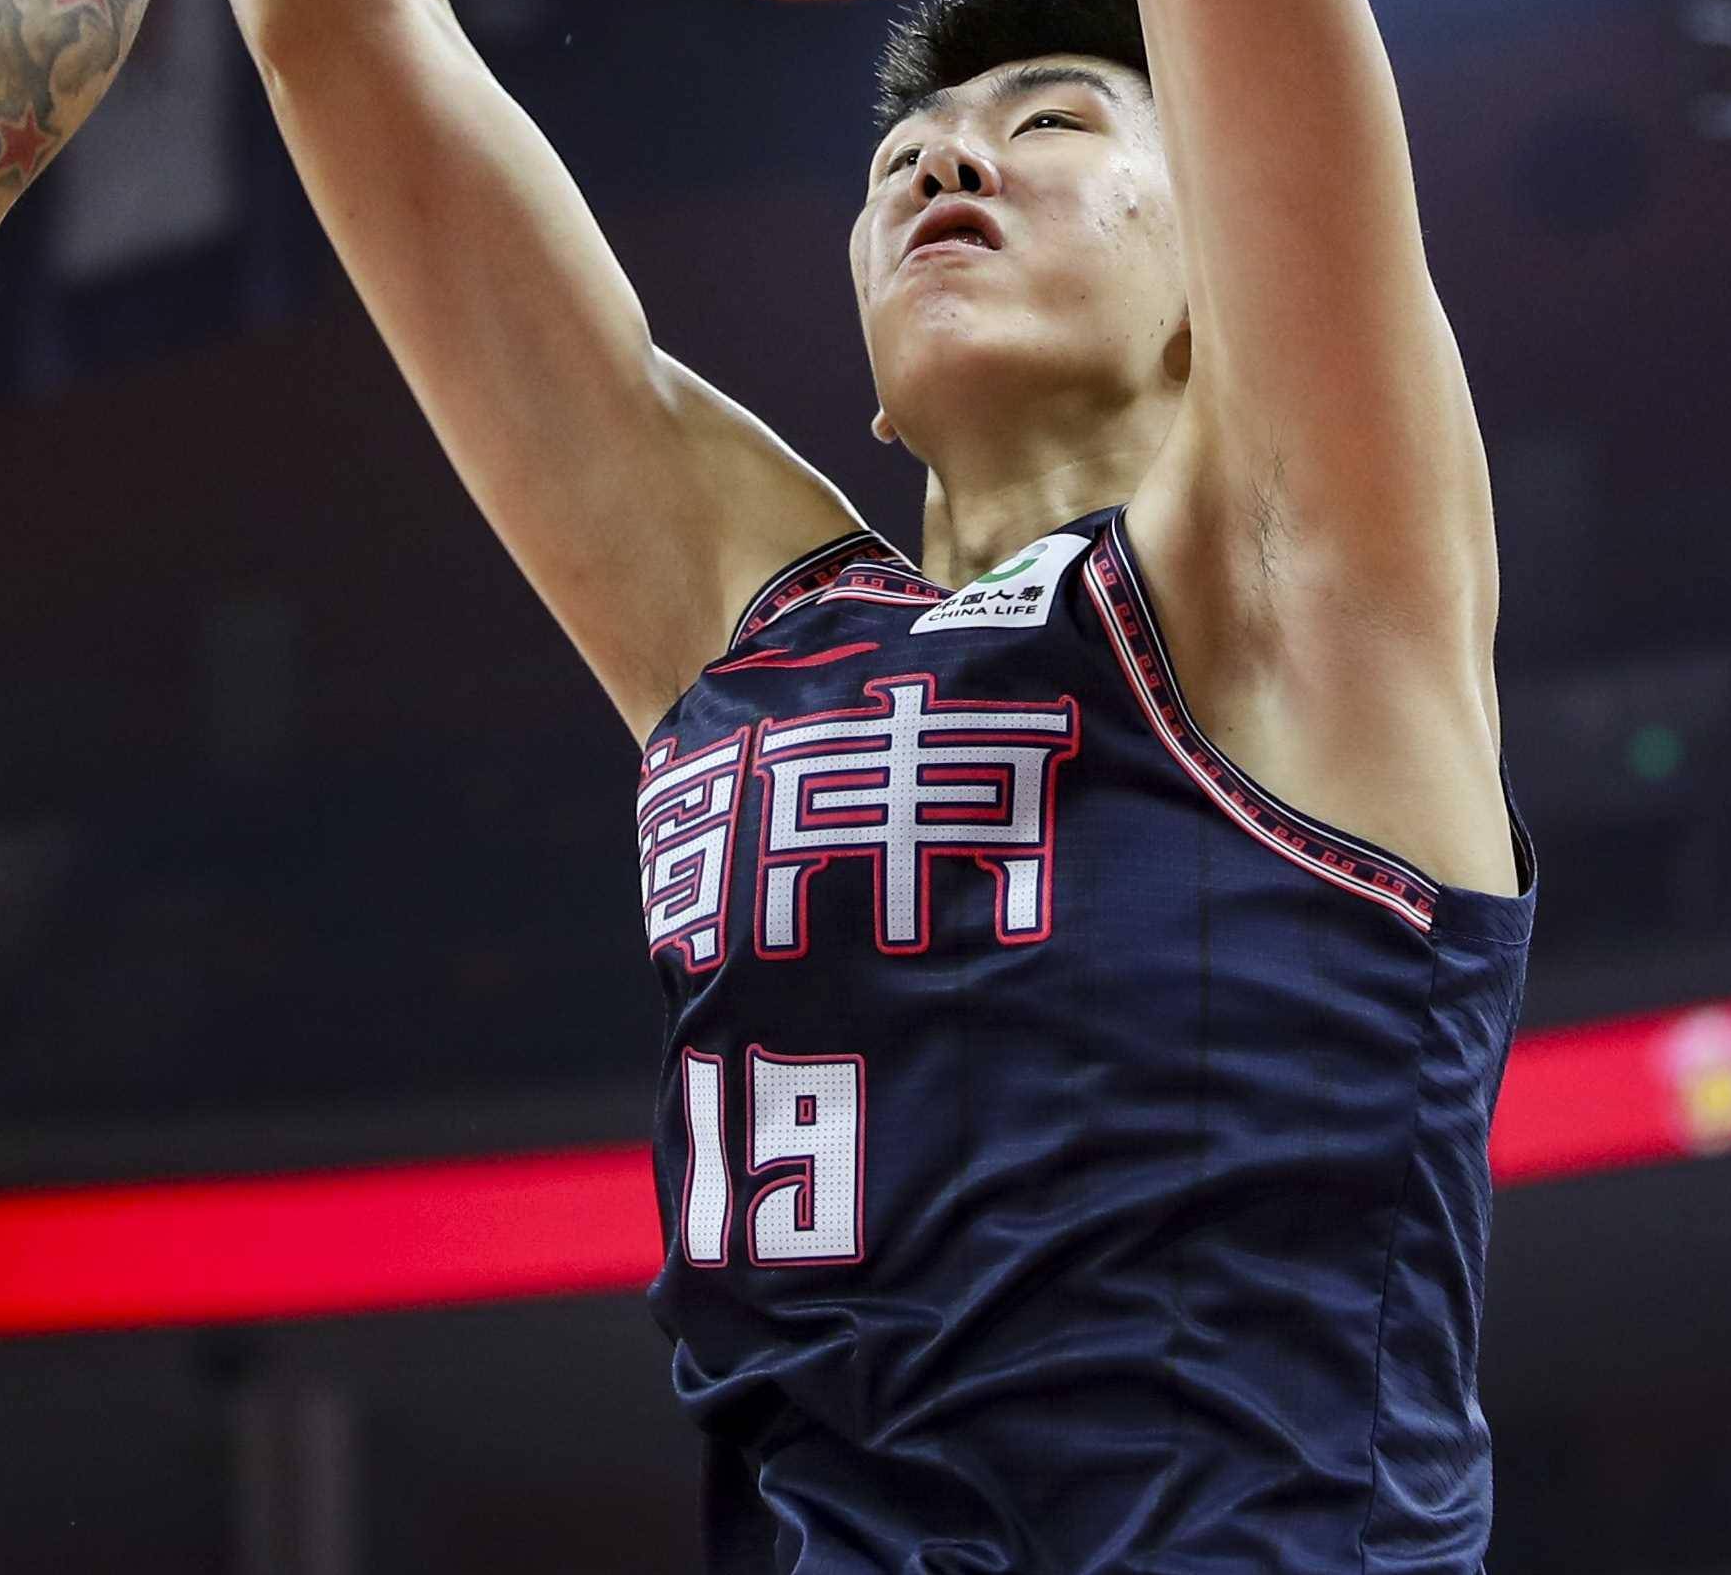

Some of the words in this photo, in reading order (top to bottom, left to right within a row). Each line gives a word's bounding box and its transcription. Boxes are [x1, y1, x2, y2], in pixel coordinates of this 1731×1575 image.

[936, 585, 1045, 611] 中国人寿
[928, 607, 988, 622] CHINA
[994, 604, 1038, 616] LIFE
[681, 1043, 866, 1268] 19
